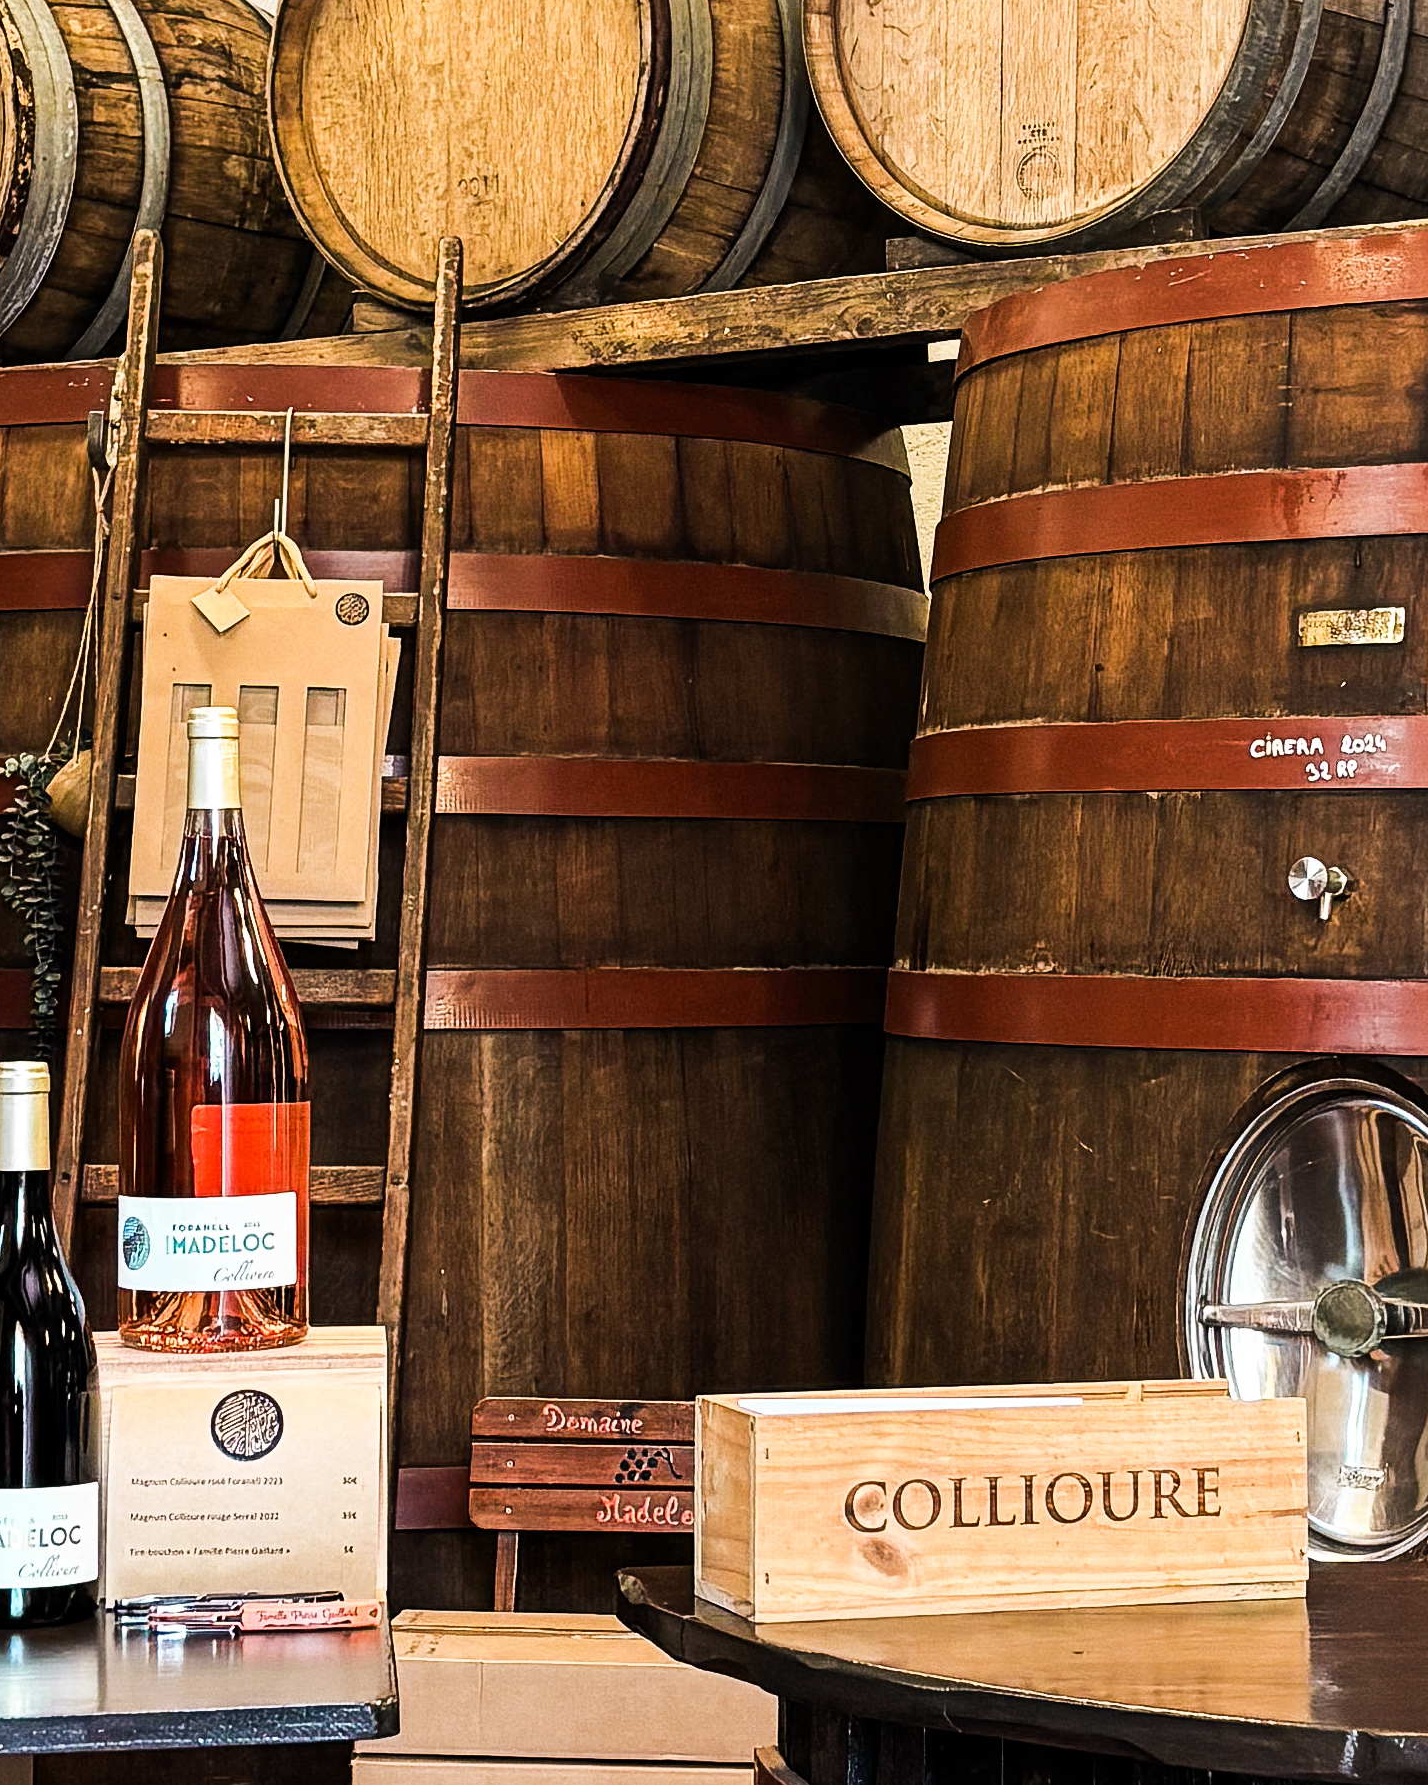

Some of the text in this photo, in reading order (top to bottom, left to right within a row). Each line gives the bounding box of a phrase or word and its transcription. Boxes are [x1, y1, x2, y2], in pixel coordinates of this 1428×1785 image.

[1340, 733, 1387, 754] 2024
[1305, 760, 1332, 782] 32
[172, 1232, 275, 1255] MADELOC
[542, 1403, 643, 1433] Domaine
[843, 1466, 1222, 1533] COLLIOURE
